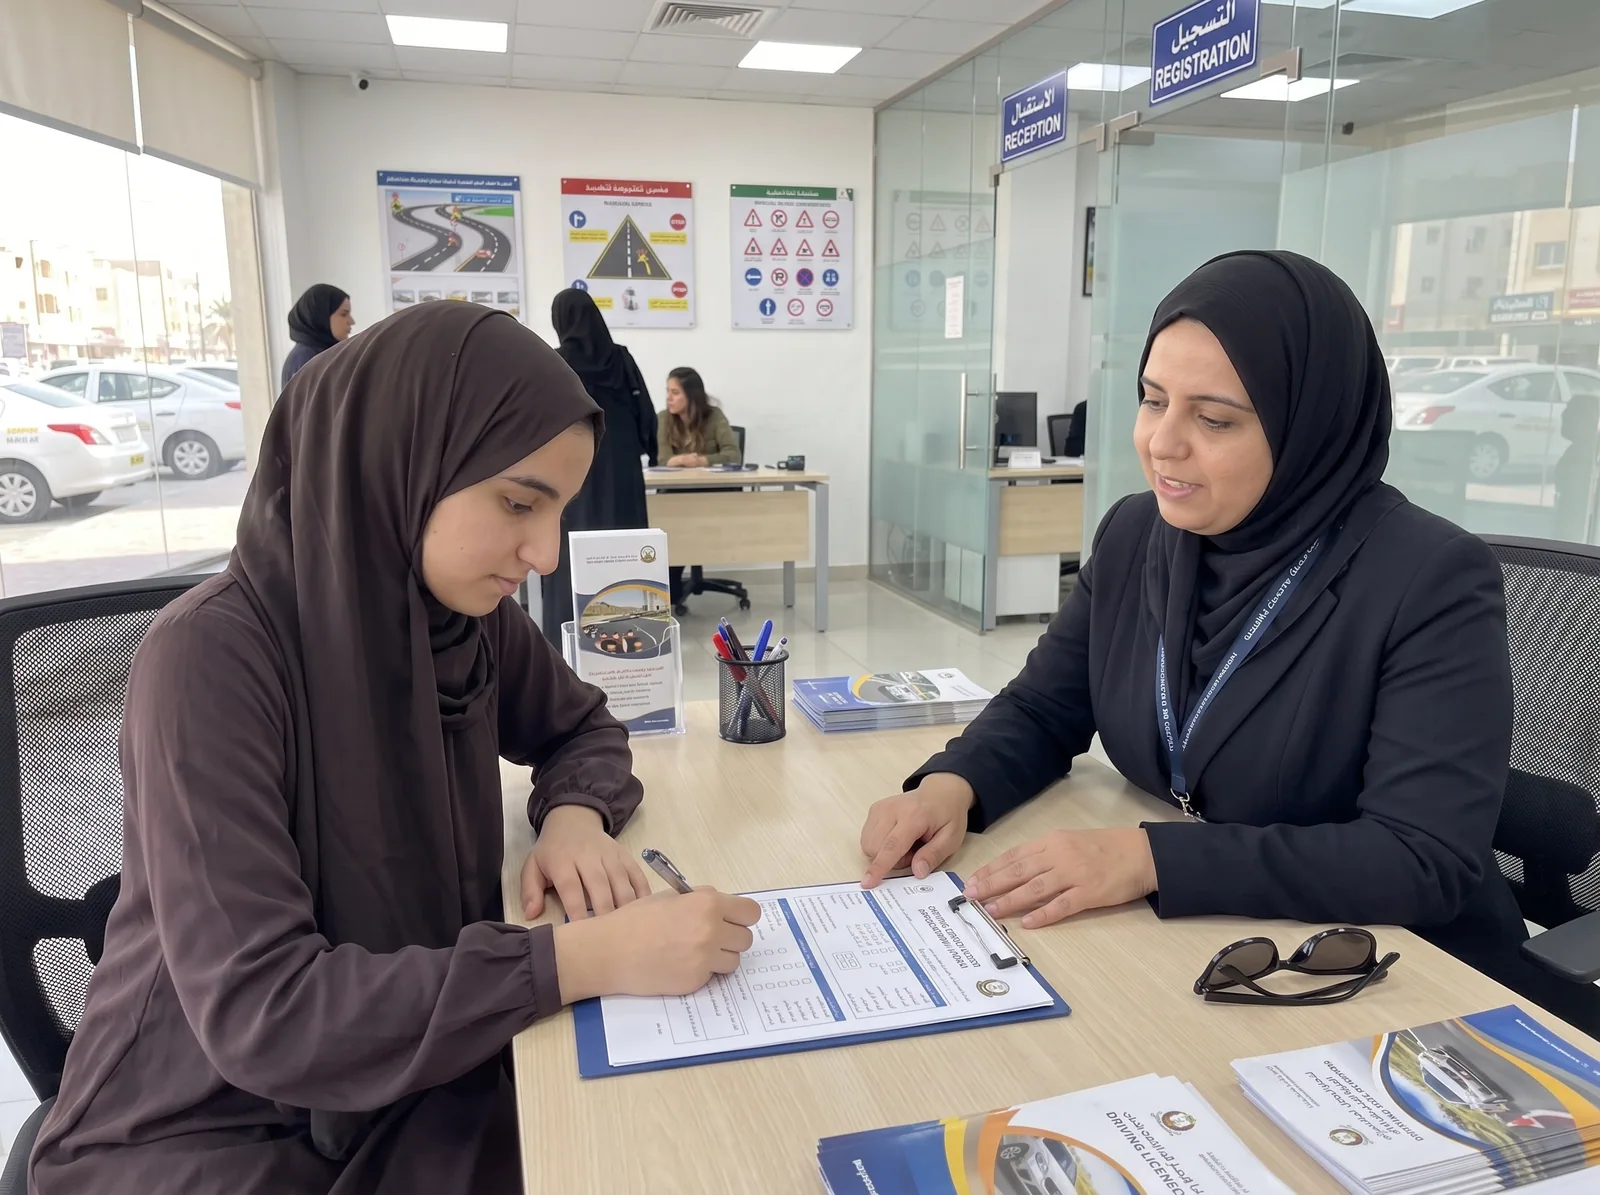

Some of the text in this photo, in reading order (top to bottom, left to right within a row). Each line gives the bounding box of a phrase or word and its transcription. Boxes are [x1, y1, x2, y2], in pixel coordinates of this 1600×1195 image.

[1171, 0, 1236, 54] التسجيل
[1154, 29, 1251, 92] REGISTRATION
[1011, 84, 1056, 126] الاستقبال
[1004, 111, 1061, 153] RECEPTION
[1106, 1111, 1145, 1152] DRIVING
